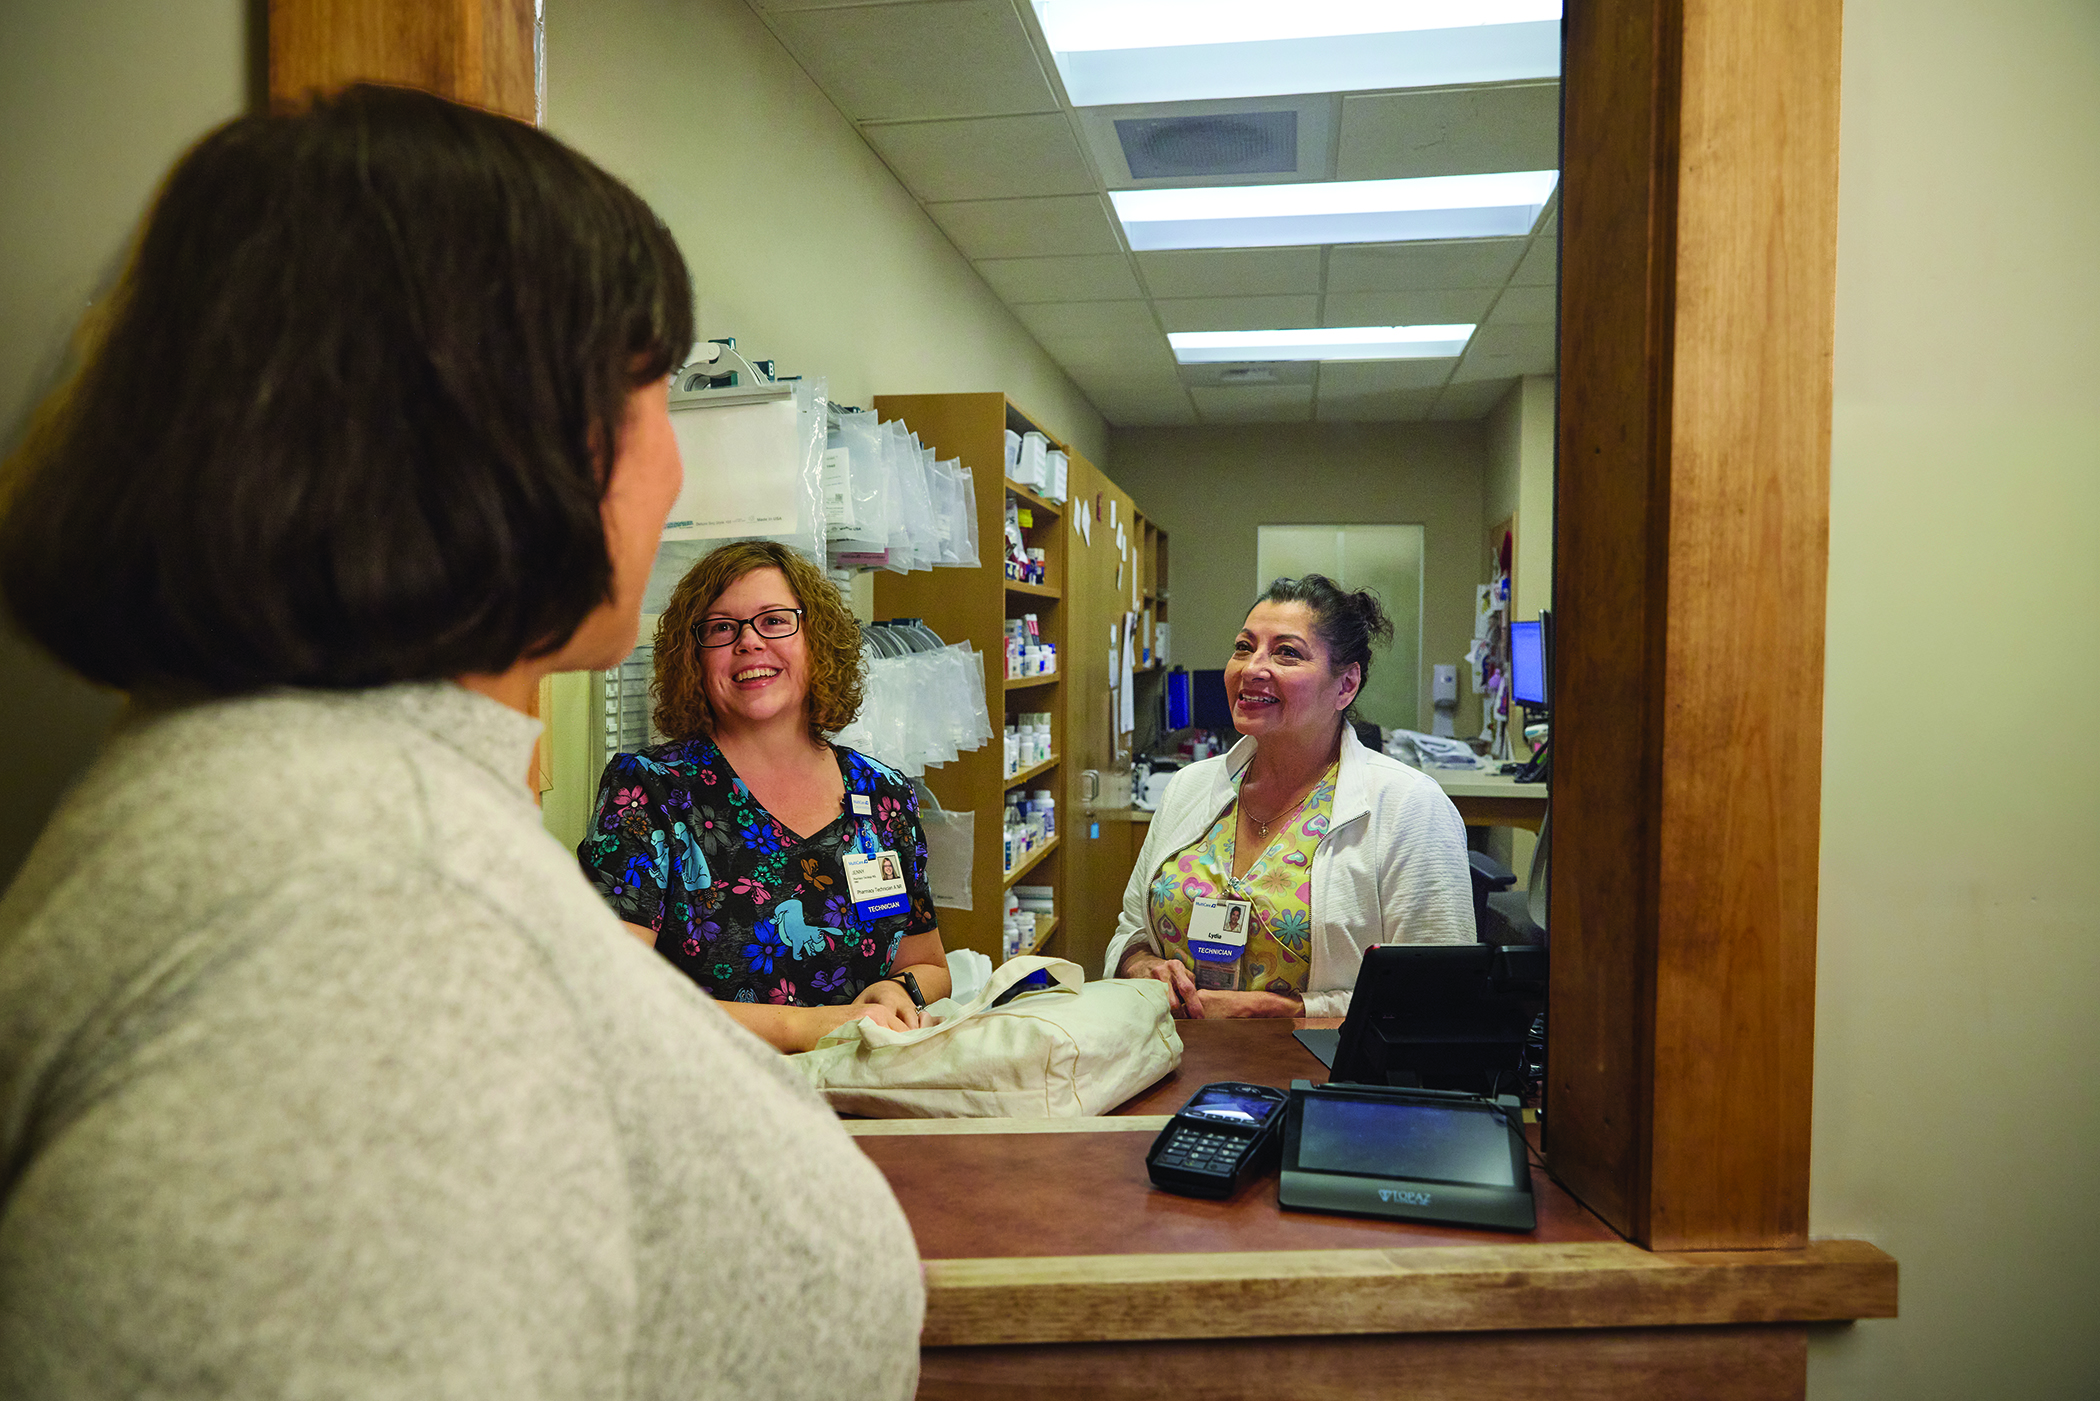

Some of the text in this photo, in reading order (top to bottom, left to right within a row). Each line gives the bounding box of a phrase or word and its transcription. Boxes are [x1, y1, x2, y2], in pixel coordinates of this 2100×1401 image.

[769, 362, 774, 376] B
[868, 902, 900, 913] TECHNICIAN
[1208, 932, 1222, 940] Lydia
[1198, 947, 1232, 956] TECHNICIAN
[1393, 1190, 1431, 1206] TOPAZ
